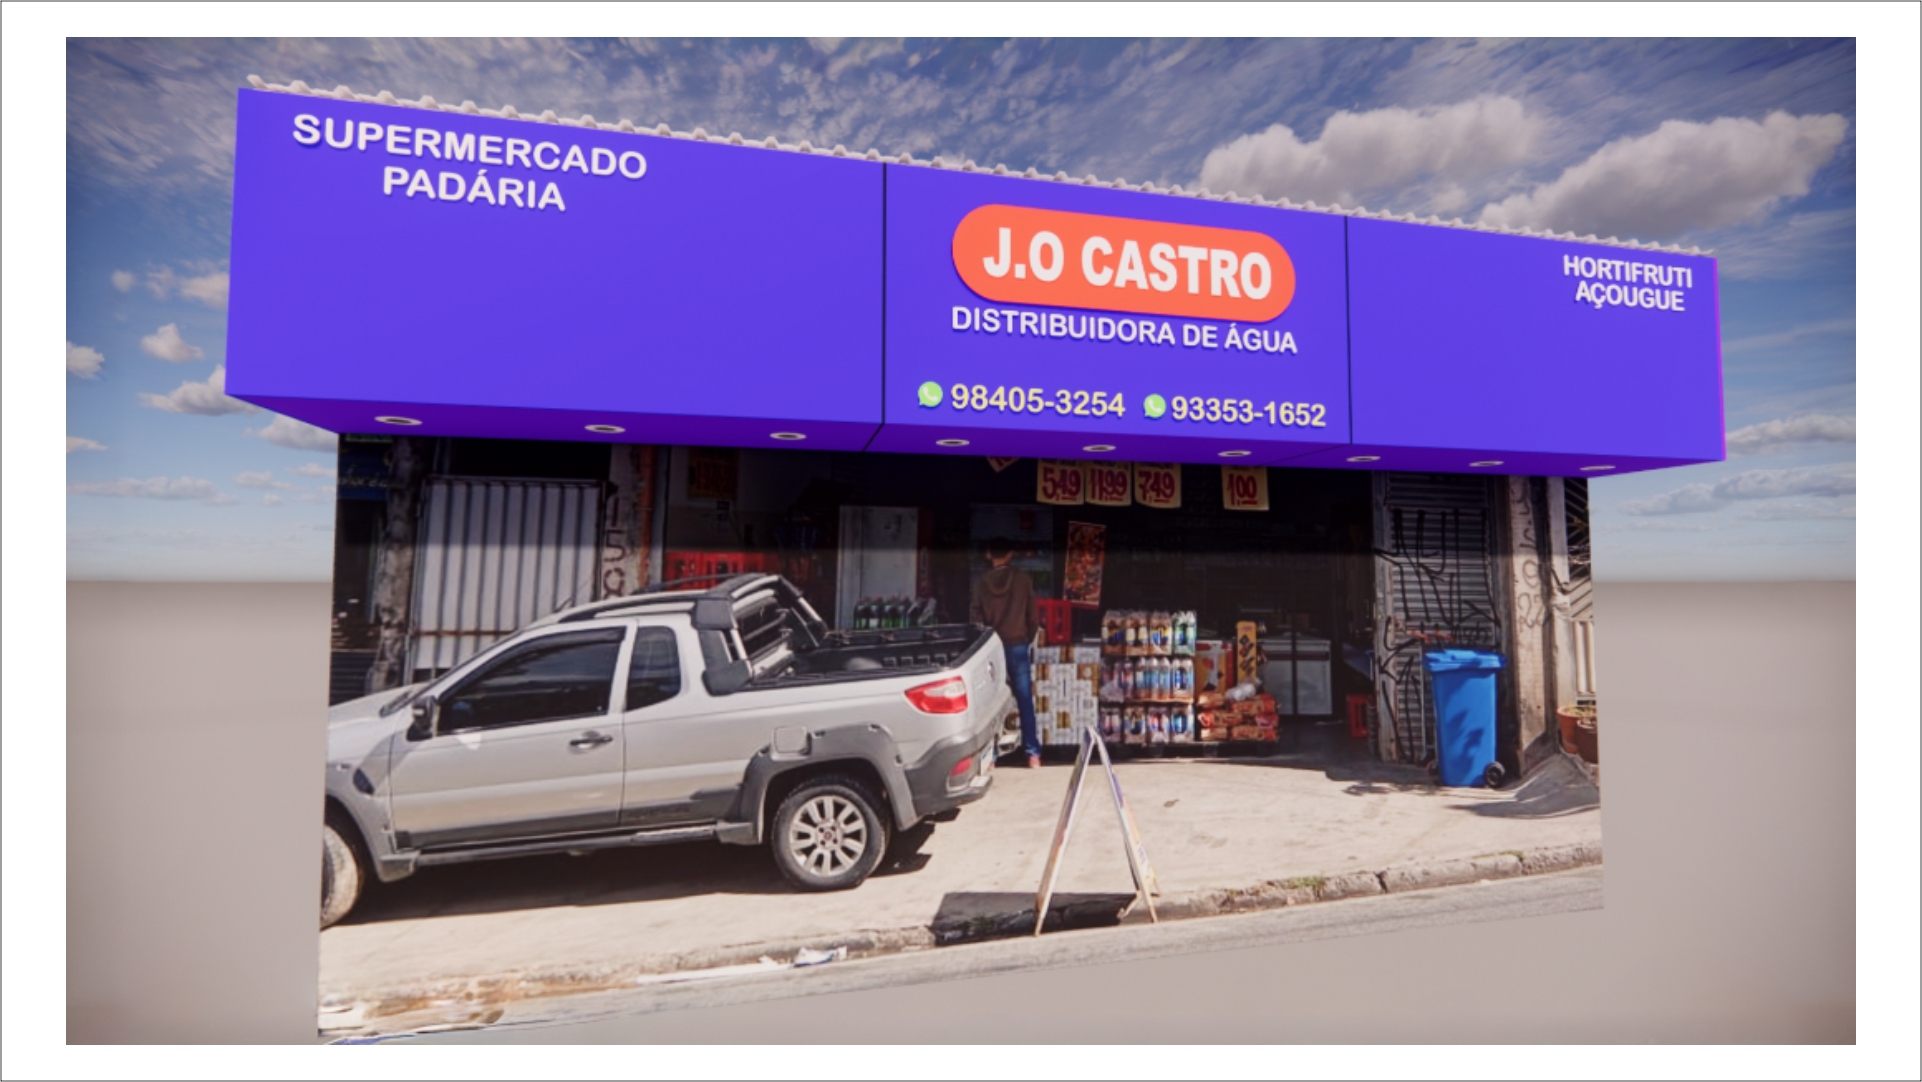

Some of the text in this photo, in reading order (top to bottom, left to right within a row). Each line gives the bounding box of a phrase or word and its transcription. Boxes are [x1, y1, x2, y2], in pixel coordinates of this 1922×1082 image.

[292, 113, 647, 179] SUPERMERCADO
[383, 165, 566, 212] PADÁRIA
[982, 227, 1272, 300] J.O CASTRO
[1563, 254, 1693, 289] HORTIFRUTI
[1575, 280, 1685, 312] AÇOUGUE
[952, 306, 1298, 354] DISTRIBUIDORA DE ÁGUA
[950, 383, 1126, 417] 98405-3254
[1171, 395, 1326, 427] 93353-1652
